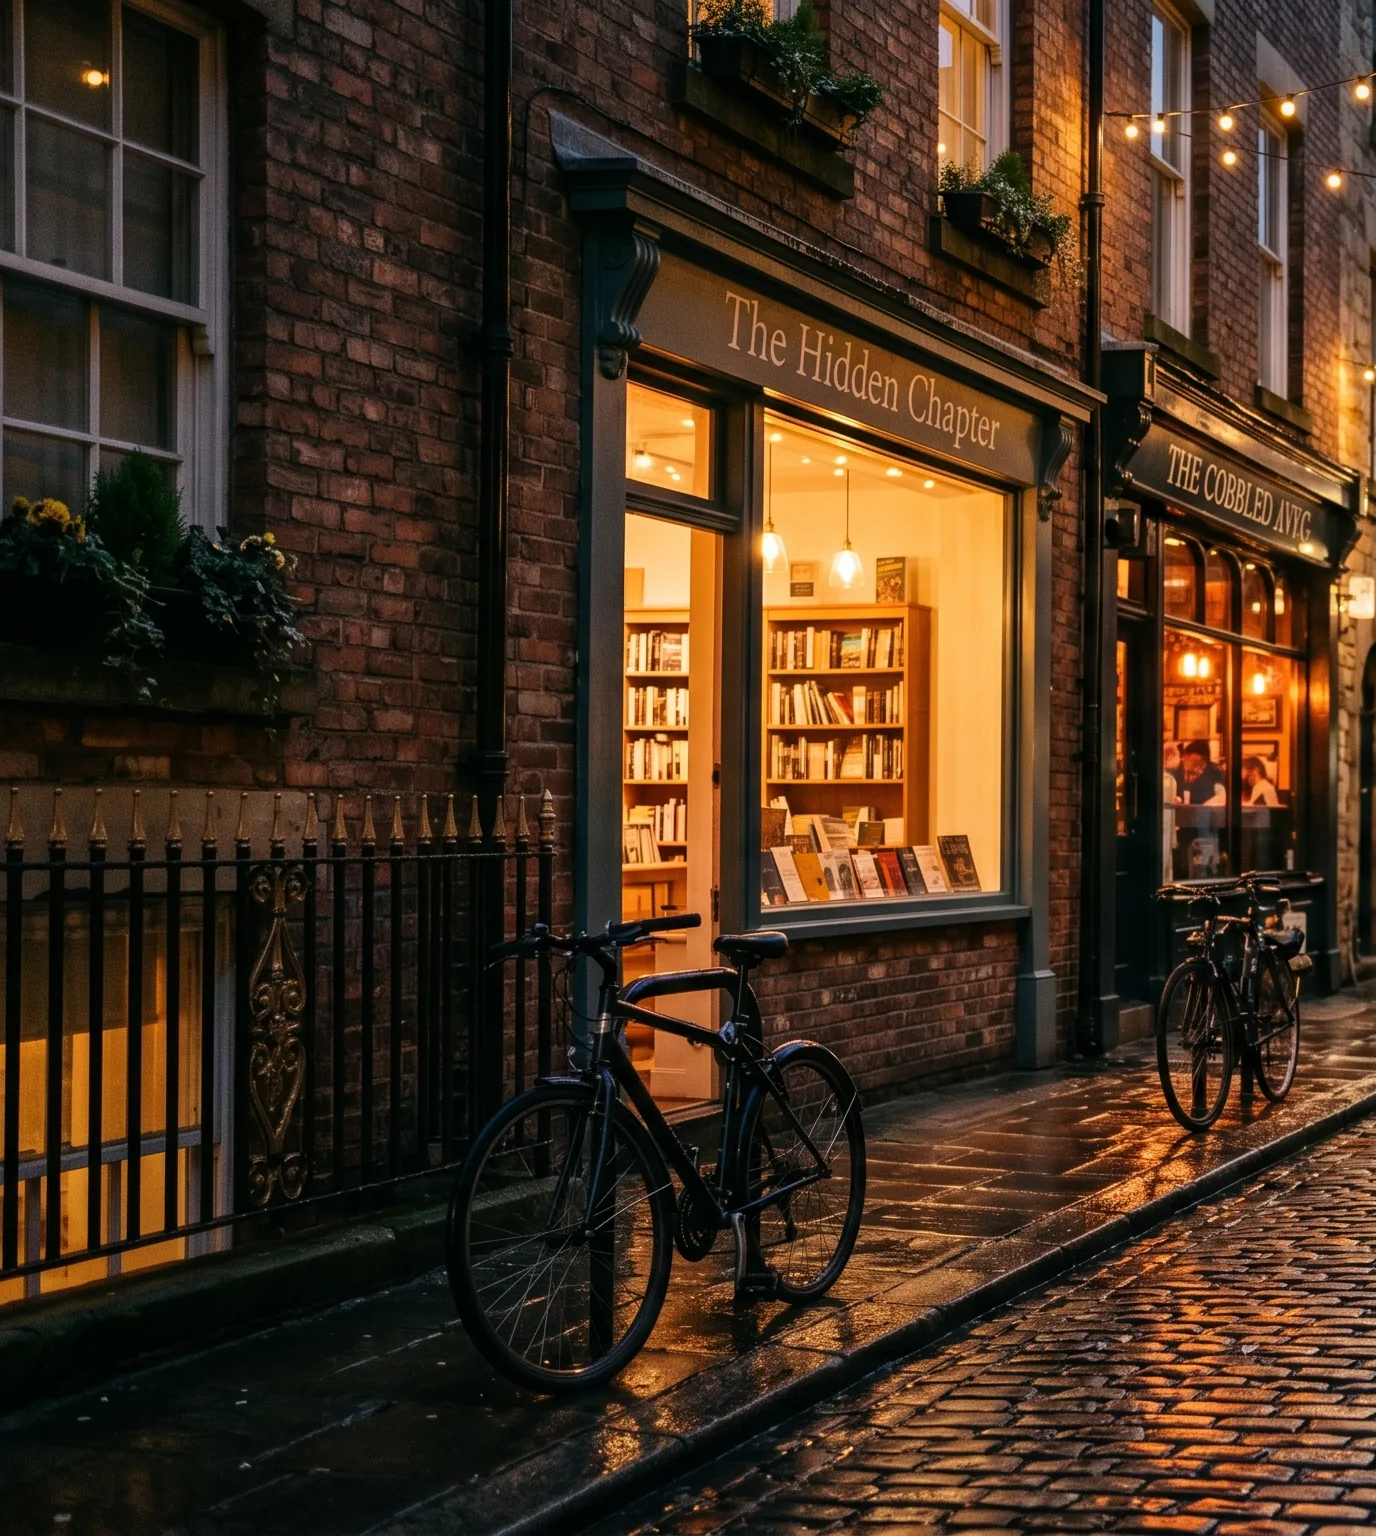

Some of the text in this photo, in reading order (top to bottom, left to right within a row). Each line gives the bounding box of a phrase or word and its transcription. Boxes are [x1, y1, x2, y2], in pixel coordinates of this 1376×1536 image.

[725, 290, 1000, 450] The Hidden Chapter
[1167, 443, 1202, 495] THE
[1204, 463, 1273, 526] COBBLED
